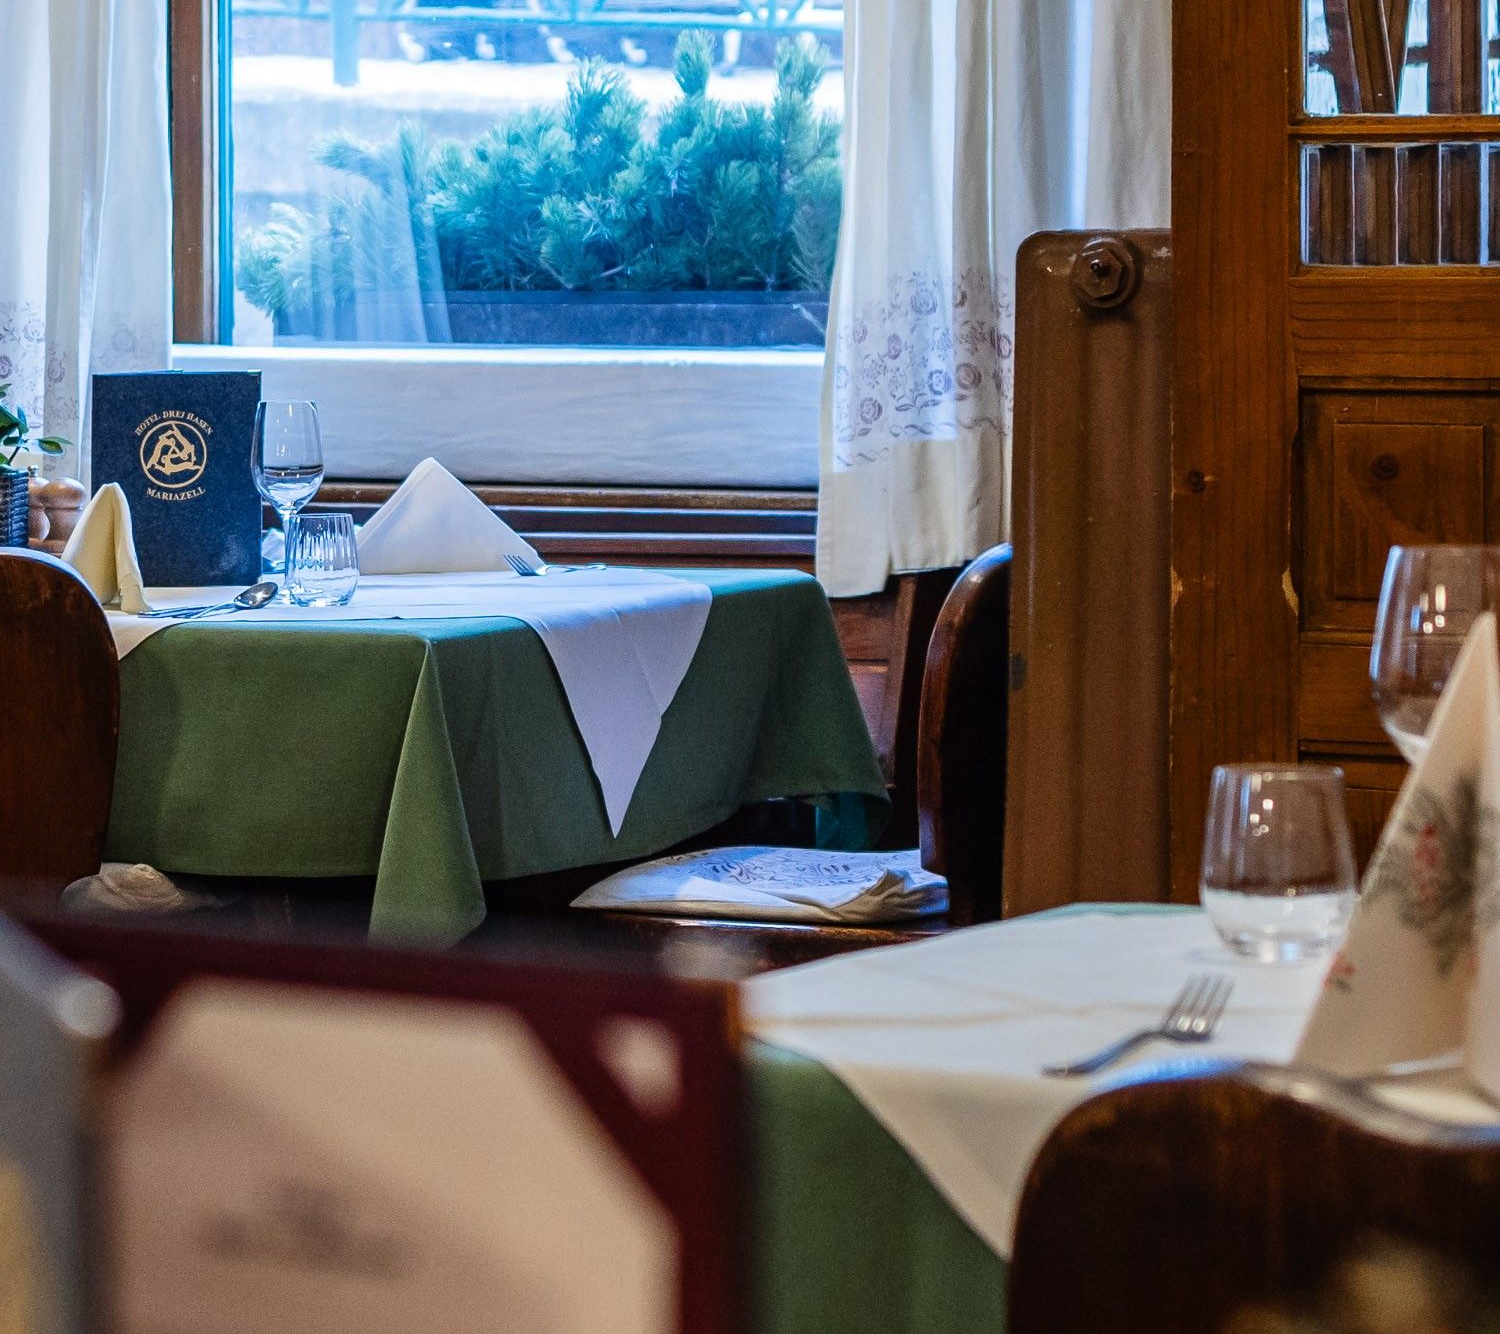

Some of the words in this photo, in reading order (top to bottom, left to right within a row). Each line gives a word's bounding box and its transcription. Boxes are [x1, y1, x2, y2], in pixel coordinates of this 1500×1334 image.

[135, 413, 160, 436] HOTEL
[163, 410, 185, 419] DREI
[186, 412, 213, 436] HASEN
[146, 486, 206, 501] MARIAZELL
